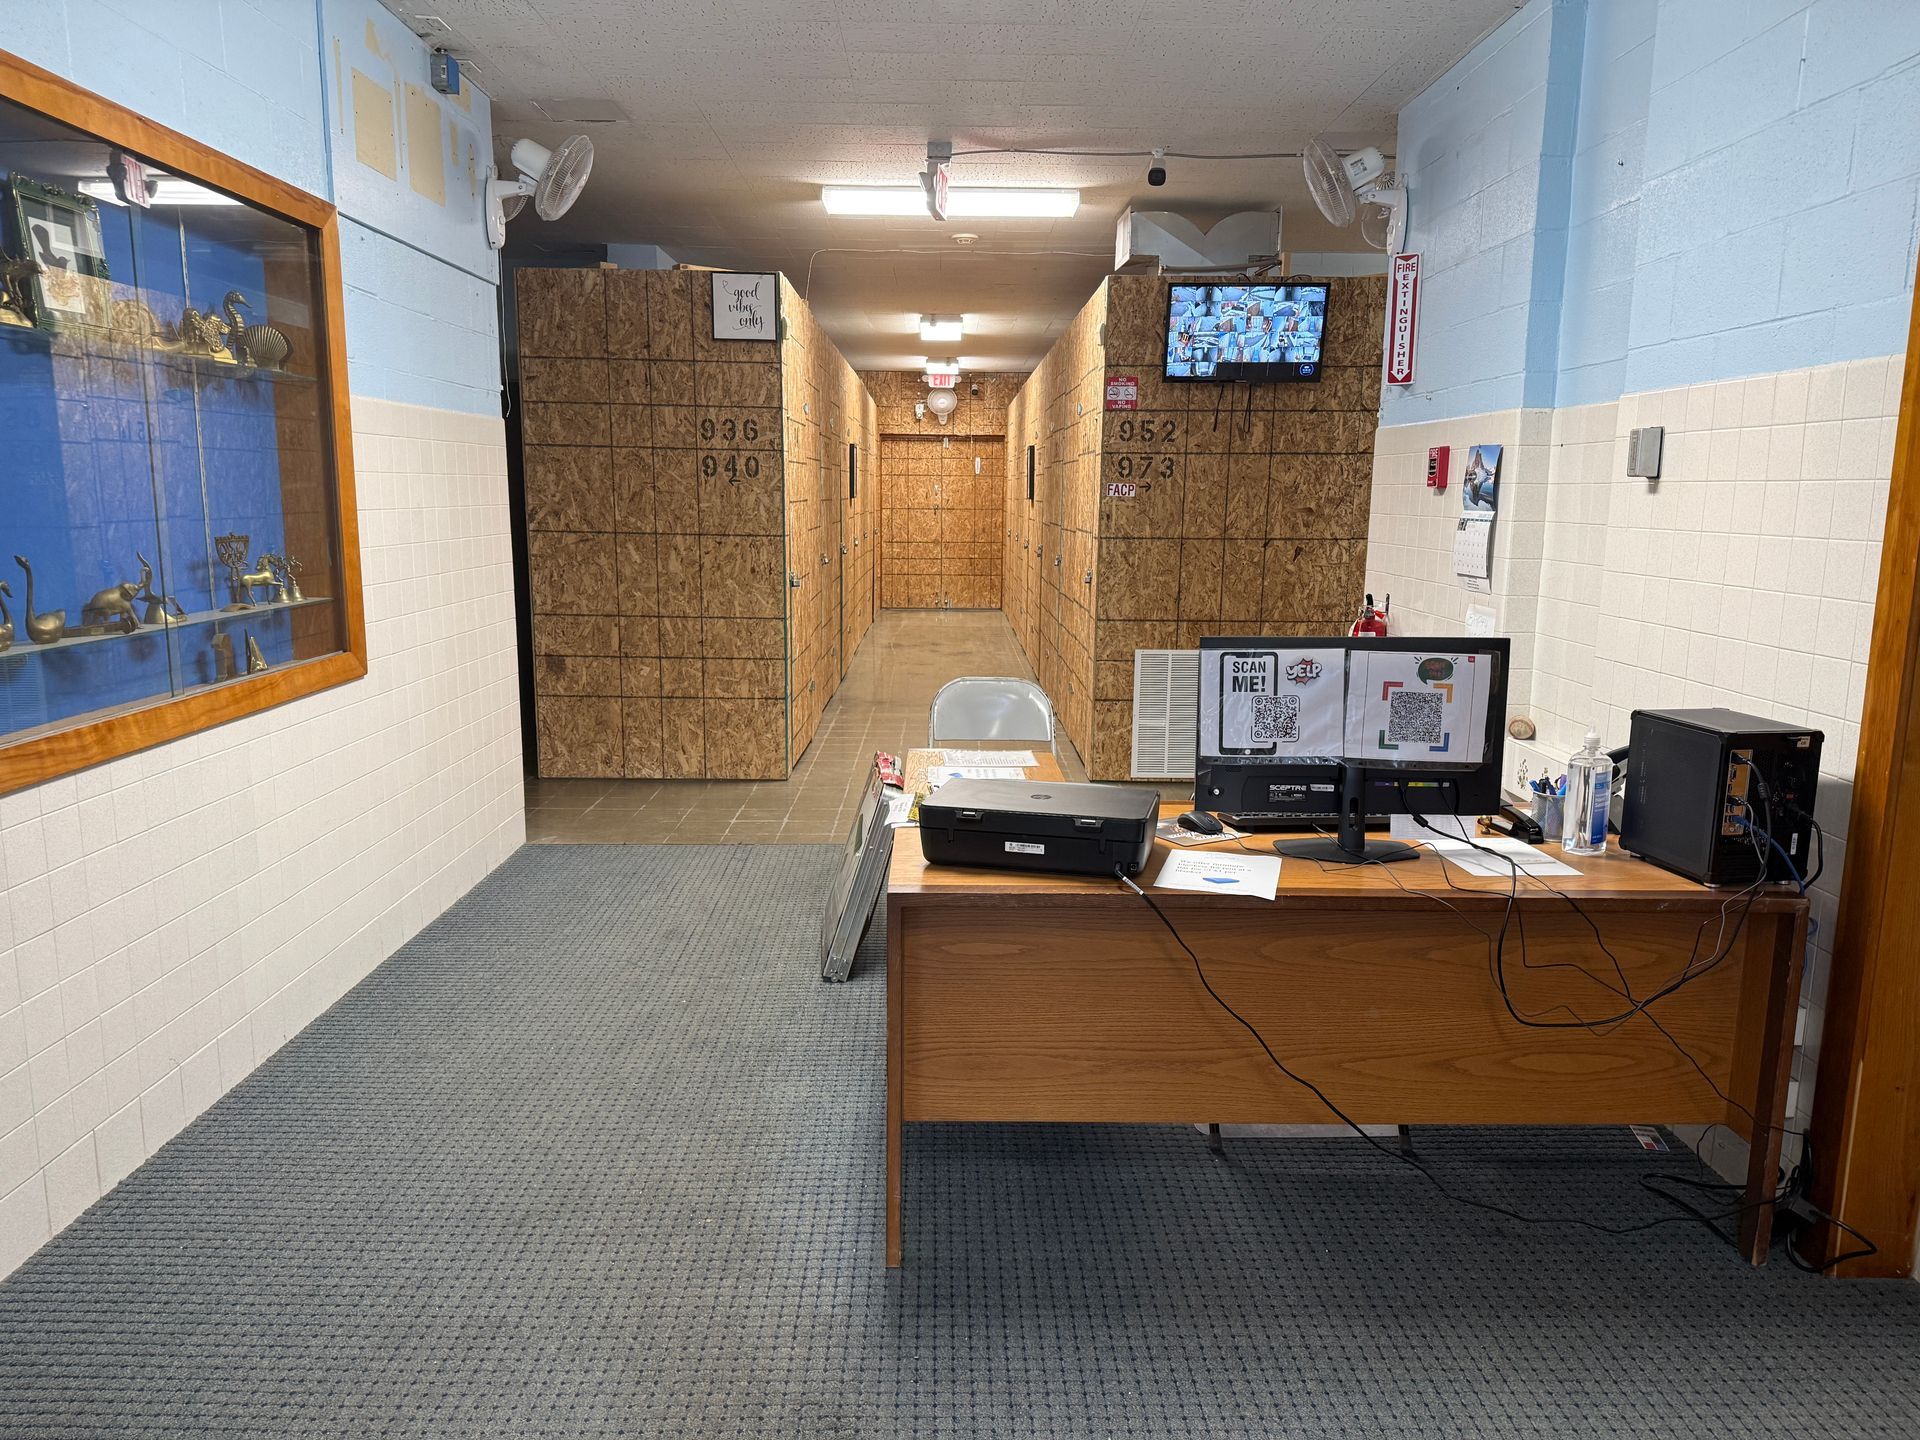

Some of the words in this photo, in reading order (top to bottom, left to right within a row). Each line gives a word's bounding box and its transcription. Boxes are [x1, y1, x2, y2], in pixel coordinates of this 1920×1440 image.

[1397, 262, 1416, 273] FIRE
[733, 281, 760, 303] good
[728, 298, 760, 315] vibes
[739, 310, 764, 334] only
[1396, 273, 1410, 376] EXTINGUISHER
[933, 374, 951, 386] EXIT
[701, 418, 758, 441] 936
[1119, 420, 1176, 442] 952
[702, 455, 759, 478] 940
[1118, 456, 1175, 479] 973
[1107, 484, 1135, 496] FACP
[1232, 661, 1266, 673] SCAN
[1286, 662, 1323, 679] YELP
[1232, 675, 1266, 693] ME!
